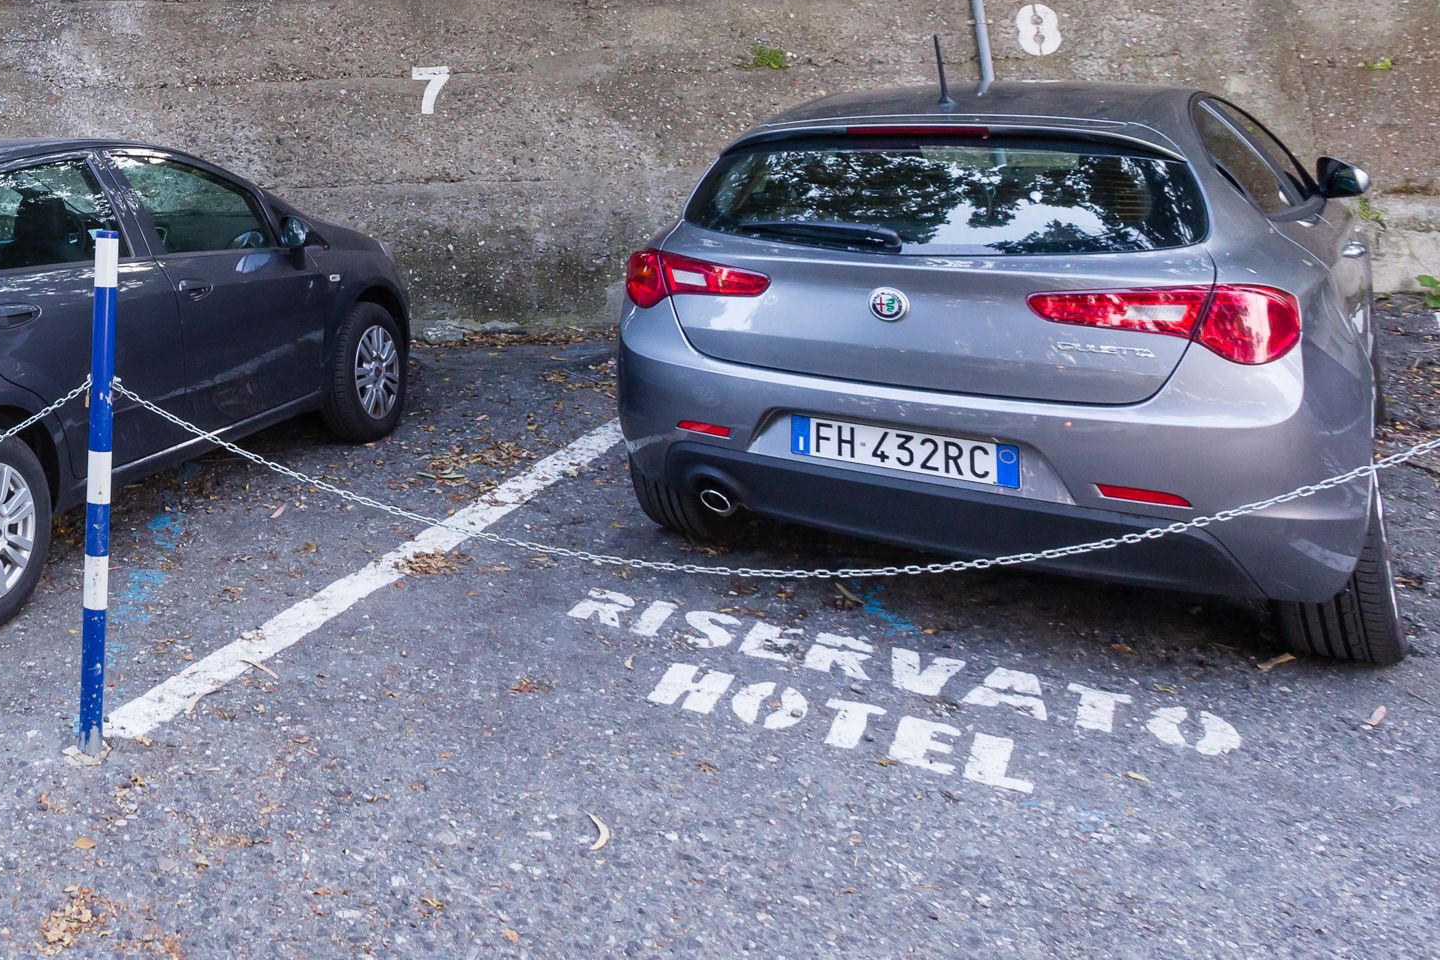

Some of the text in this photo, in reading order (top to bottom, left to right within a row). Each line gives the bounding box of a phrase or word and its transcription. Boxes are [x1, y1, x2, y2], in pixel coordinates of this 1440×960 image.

[1015, 4, 1062, 56] 8
[411, 66, 450, 115] 7
[566, 587, 1242, 756] RISERVATO
[647, 662, 1034, 793] HOTEL
